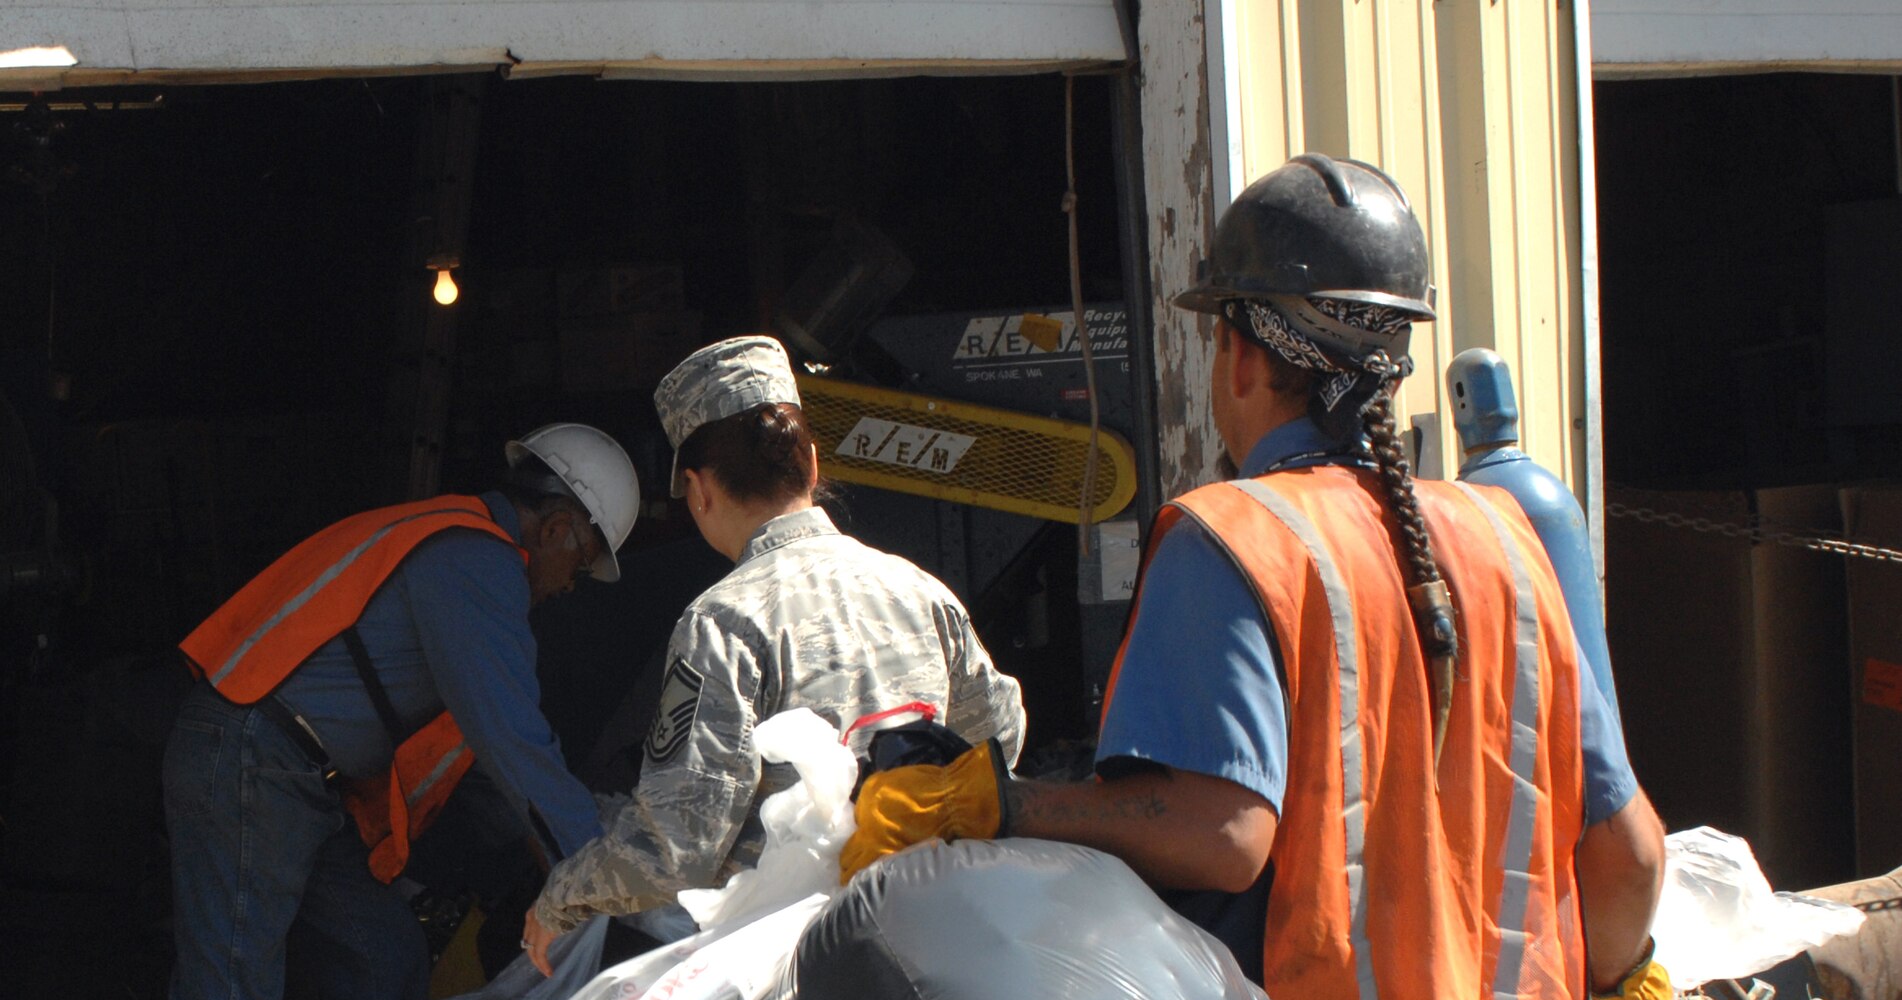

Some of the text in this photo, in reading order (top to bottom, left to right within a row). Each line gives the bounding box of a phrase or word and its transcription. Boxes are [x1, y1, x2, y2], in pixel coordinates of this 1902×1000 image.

[1068, 337, 1128, 352] Mnufa
[965, 367, 1043, 382] SPOKANE WA
